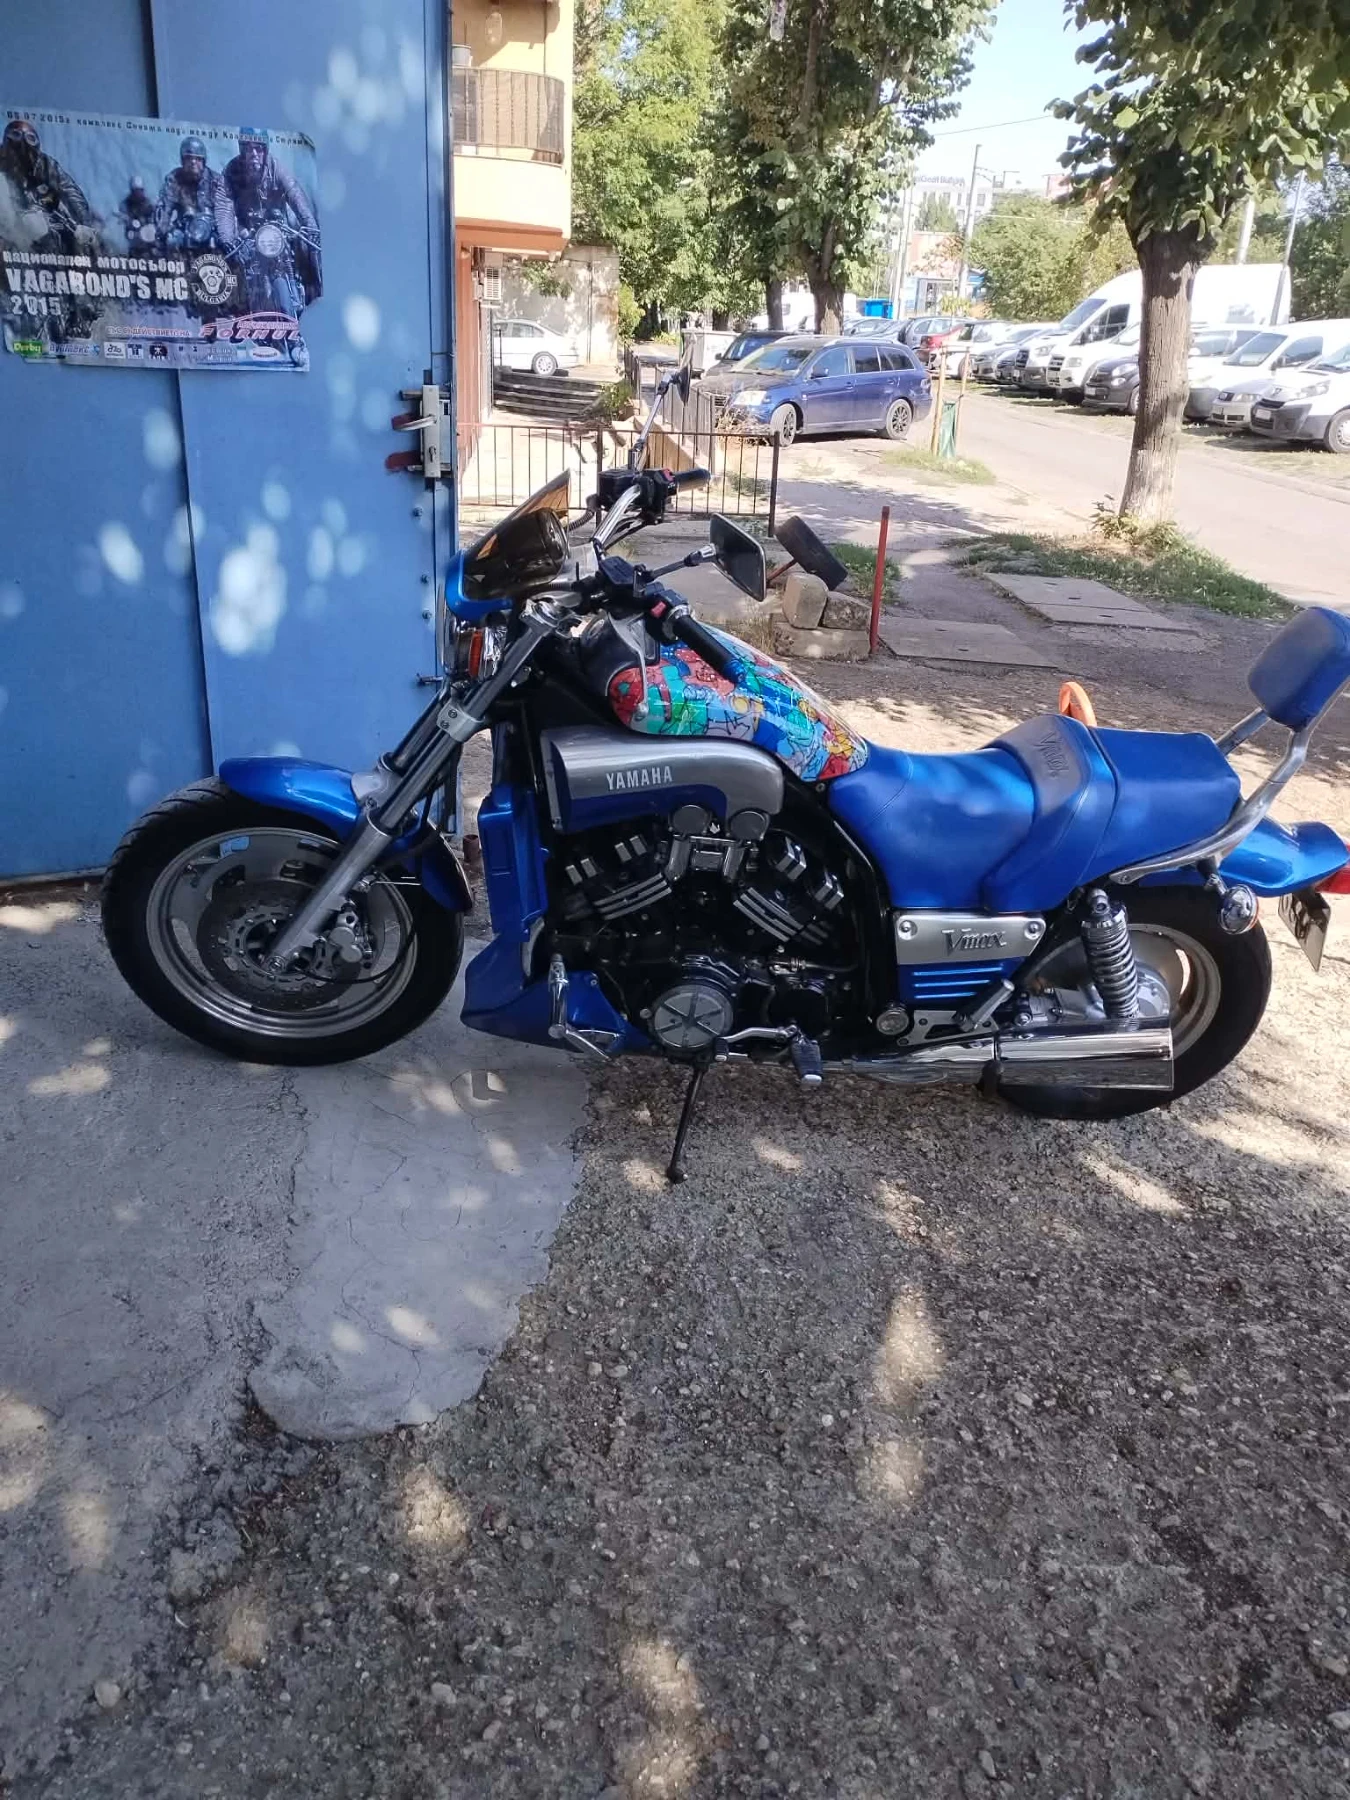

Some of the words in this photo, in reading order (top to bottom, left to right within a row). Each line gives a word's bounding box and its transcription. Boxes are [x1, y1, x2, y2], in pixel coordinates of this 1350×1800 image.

[97, 256, 186, 274] мотосъбор
[5, 267, 152, 300] VAGABOND'S
[155, 276, 189, 301] MC
[10, 294, 62, 316] 2015
[606, 765, 673, 791] YAMAHA
[942, 928, 1007, 956] Vmax
